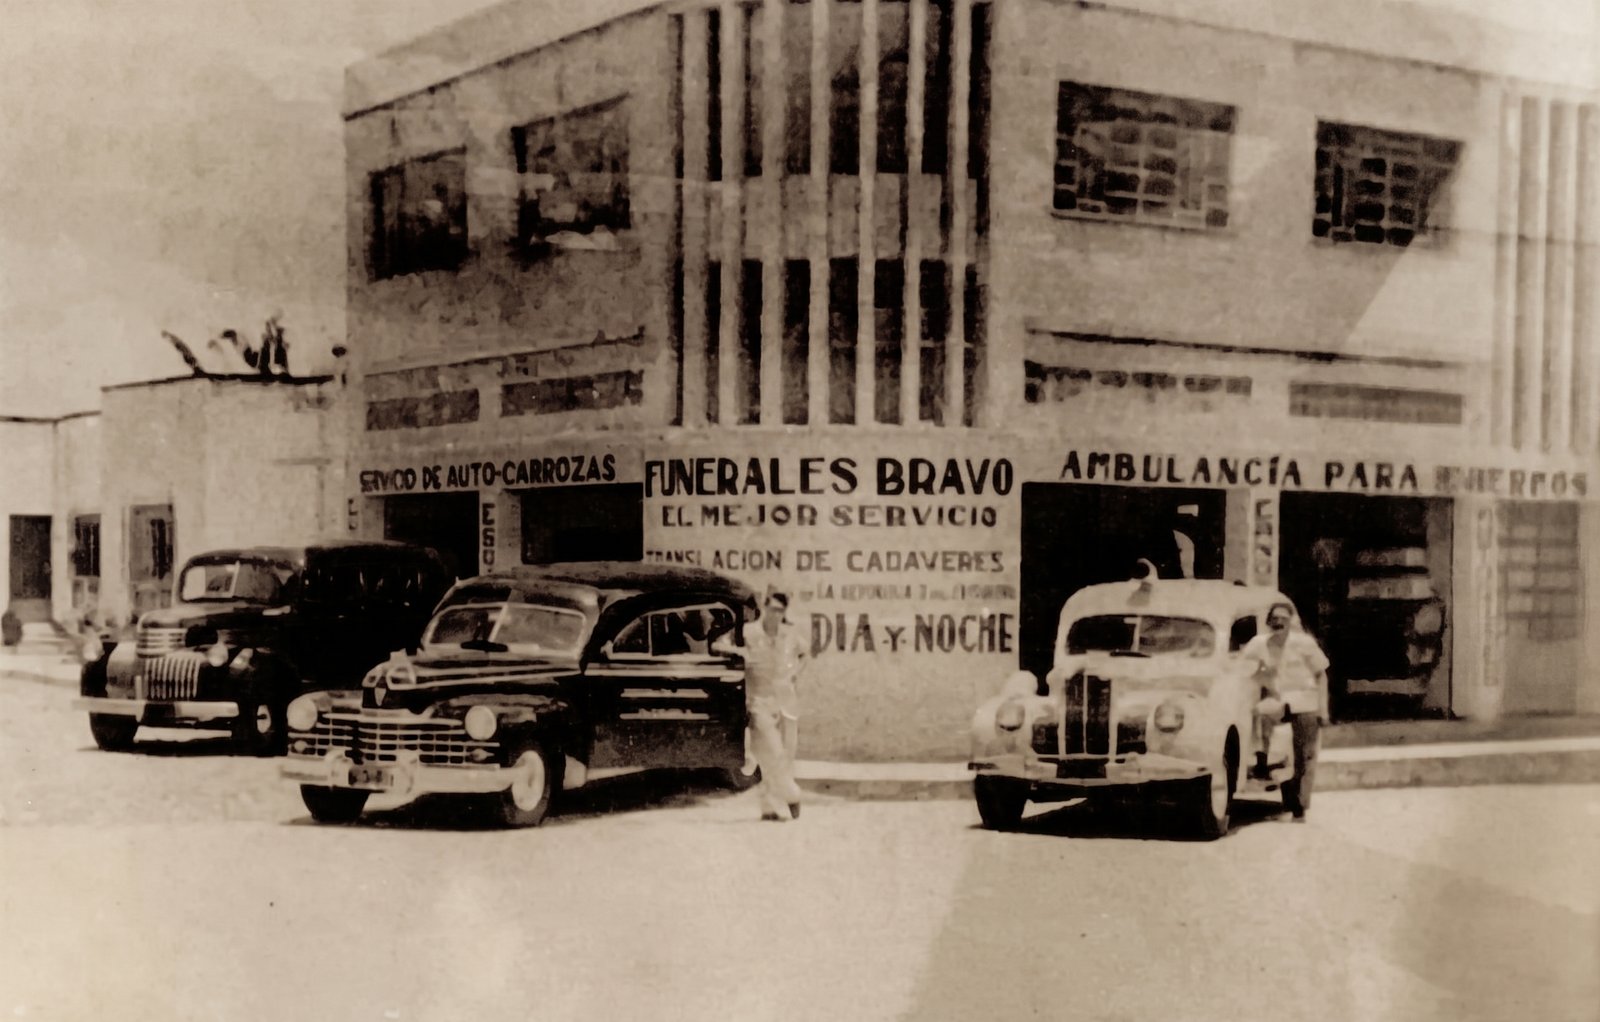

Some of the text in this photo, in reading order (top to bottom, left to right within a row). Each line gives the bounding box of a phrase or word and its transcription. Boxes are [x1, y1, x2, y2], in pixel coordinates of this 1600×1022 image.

[423, 466, 442, 490] DE
[447, 454, 616, 488] AUTO-CARROZAS
[645, 457, 1014, 498] FUNERALES BRAVO
[1325, 462, 1418, 489] PARA
[662, 504, 997, 527] EL MEJOR SERVICIO
[796, 550, 832, 572] DE
[846, 550, 1005, 573] CADAVERES
[810, 613, 876, 657] DIA
[914, 613, 1014, 654] NOCHE
